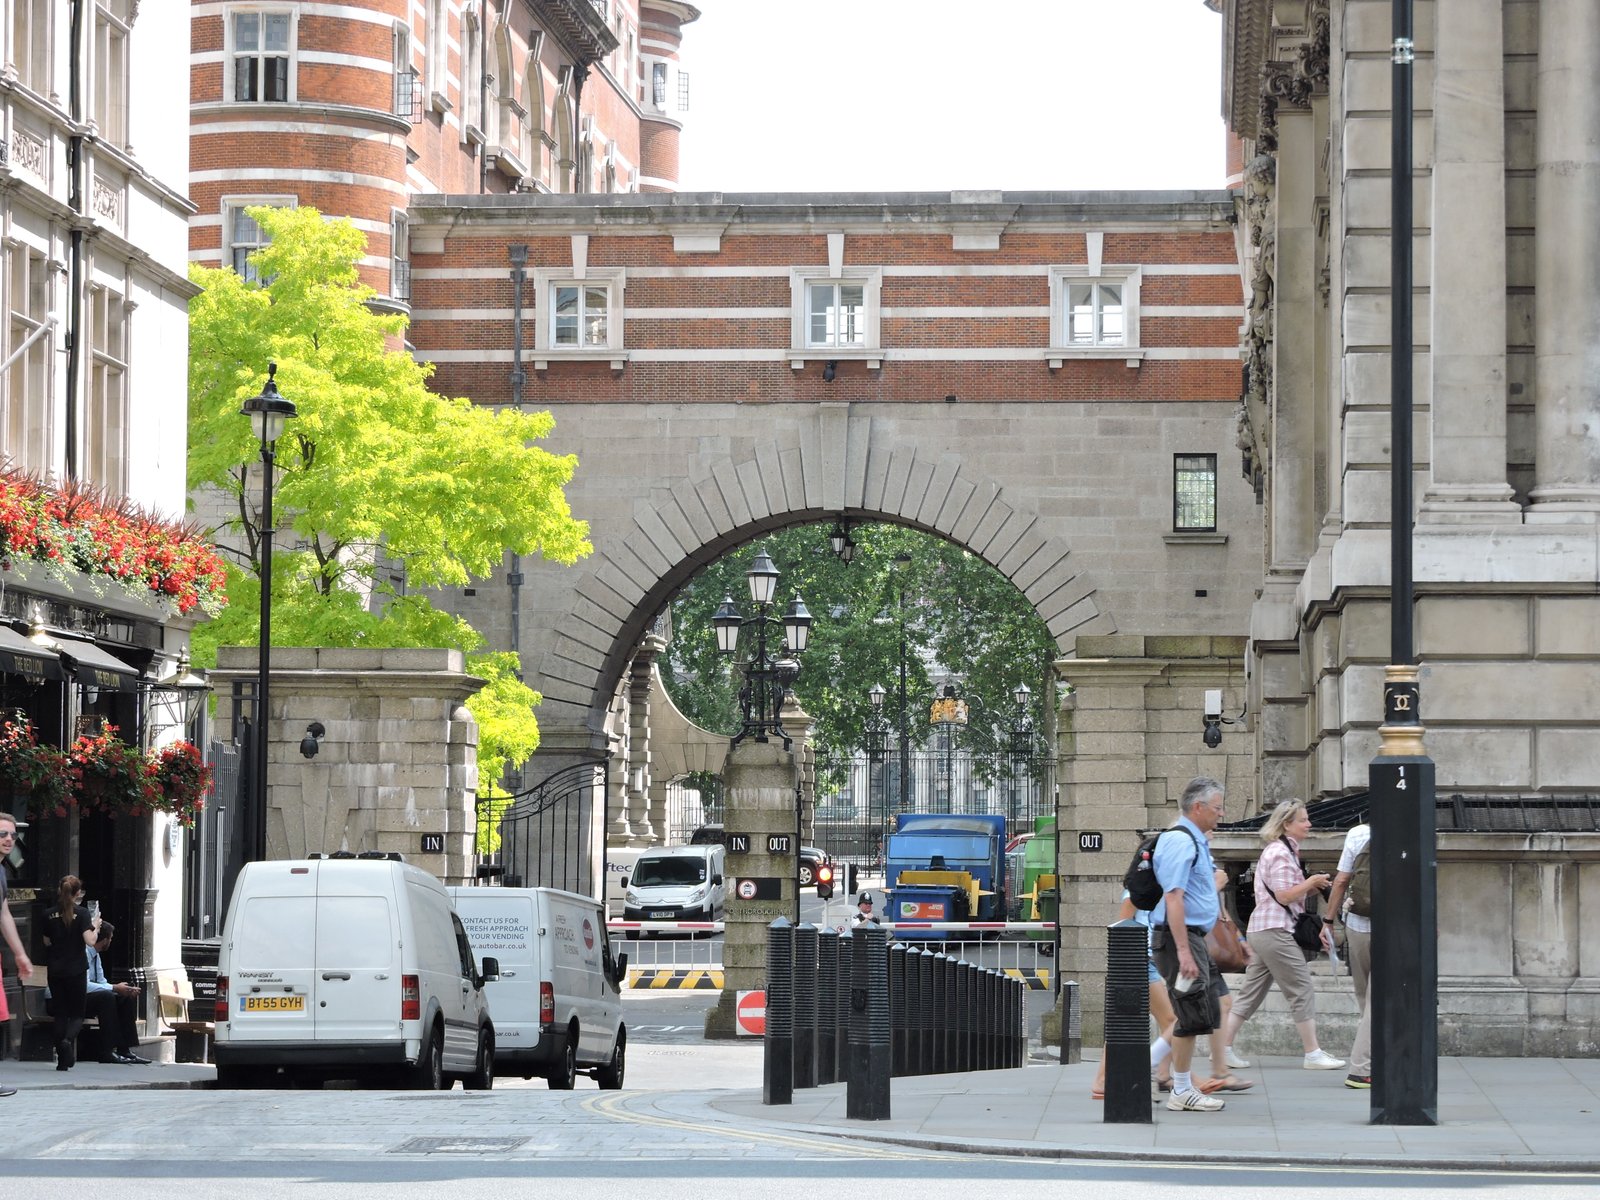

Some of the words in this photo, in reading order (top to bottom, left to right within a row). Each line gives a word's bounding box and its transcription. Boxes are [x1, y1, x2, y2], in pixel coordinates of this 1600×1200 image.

[426, 837, 440, 850] IN
[732, 837, 746, 851] IN
[769, 837, 788, 851] OUT
[1081, 834, 1101, 848] OUT
[248, 997, 278, 1009] BT55
[280, 997, 302, 1008] GYH
